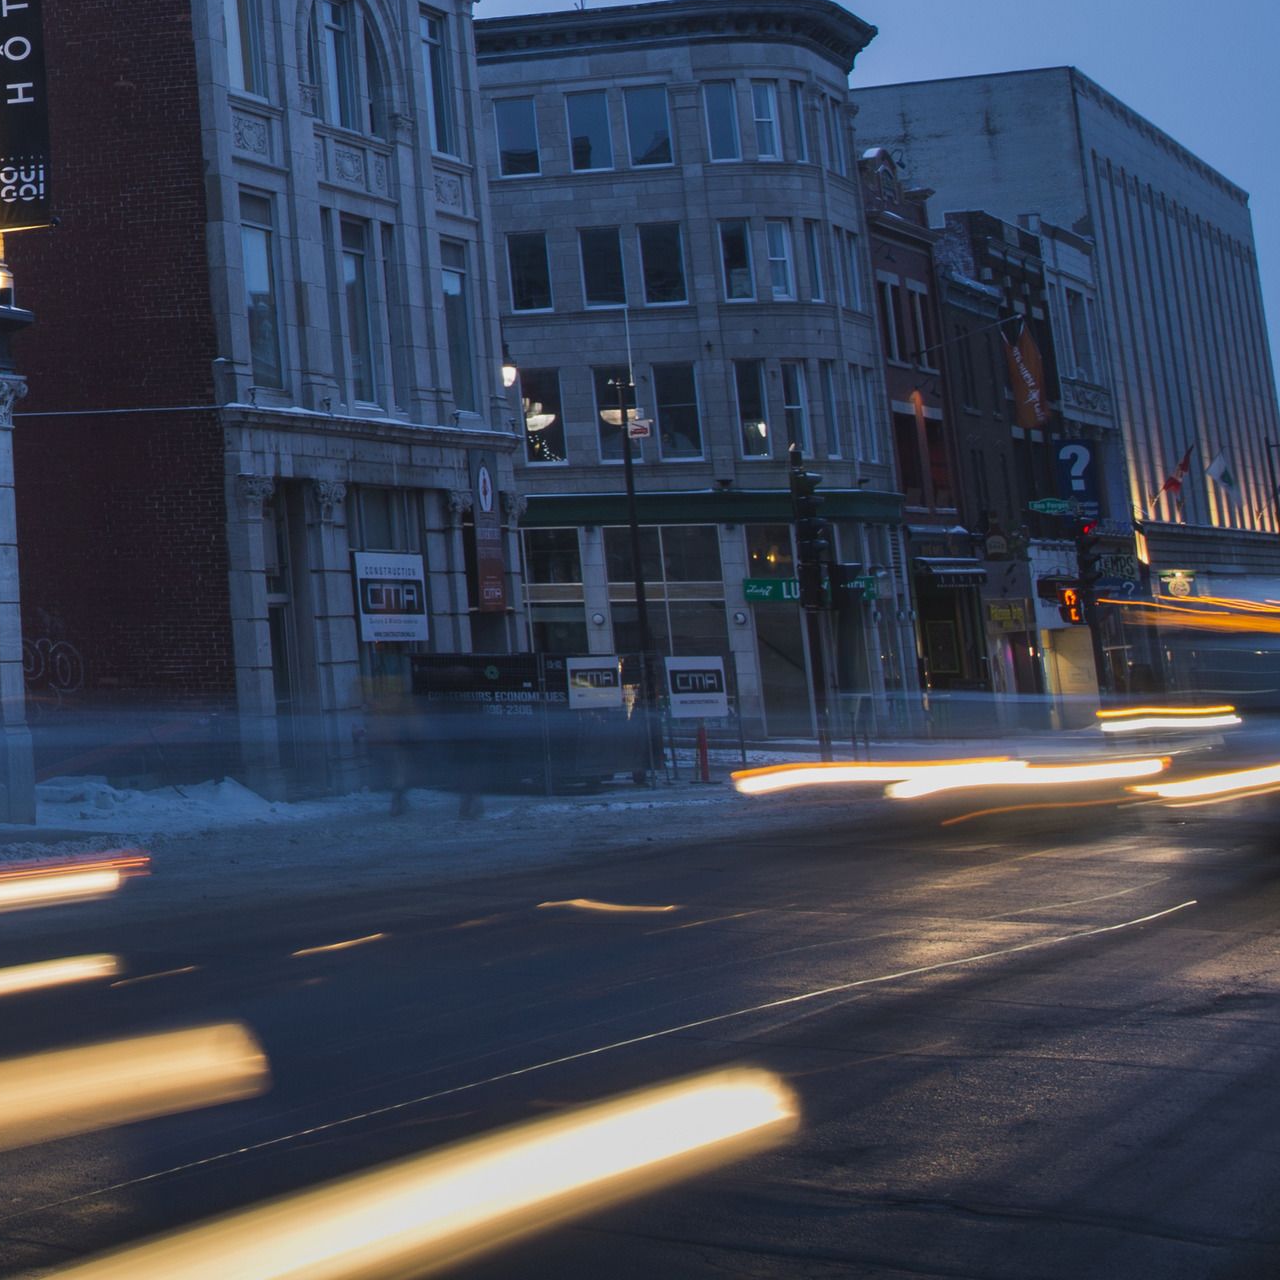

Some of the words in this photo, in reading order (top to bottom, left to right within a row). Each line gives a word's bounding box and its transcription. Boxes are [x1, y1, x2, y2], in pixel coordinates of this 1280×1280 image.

[367, 583, 418, 609] CMA
[576, 671, 614, 687] CMA
[676, 673, 718, 690] CMA
[495, 691, 567, 703] ECONOMIUES
